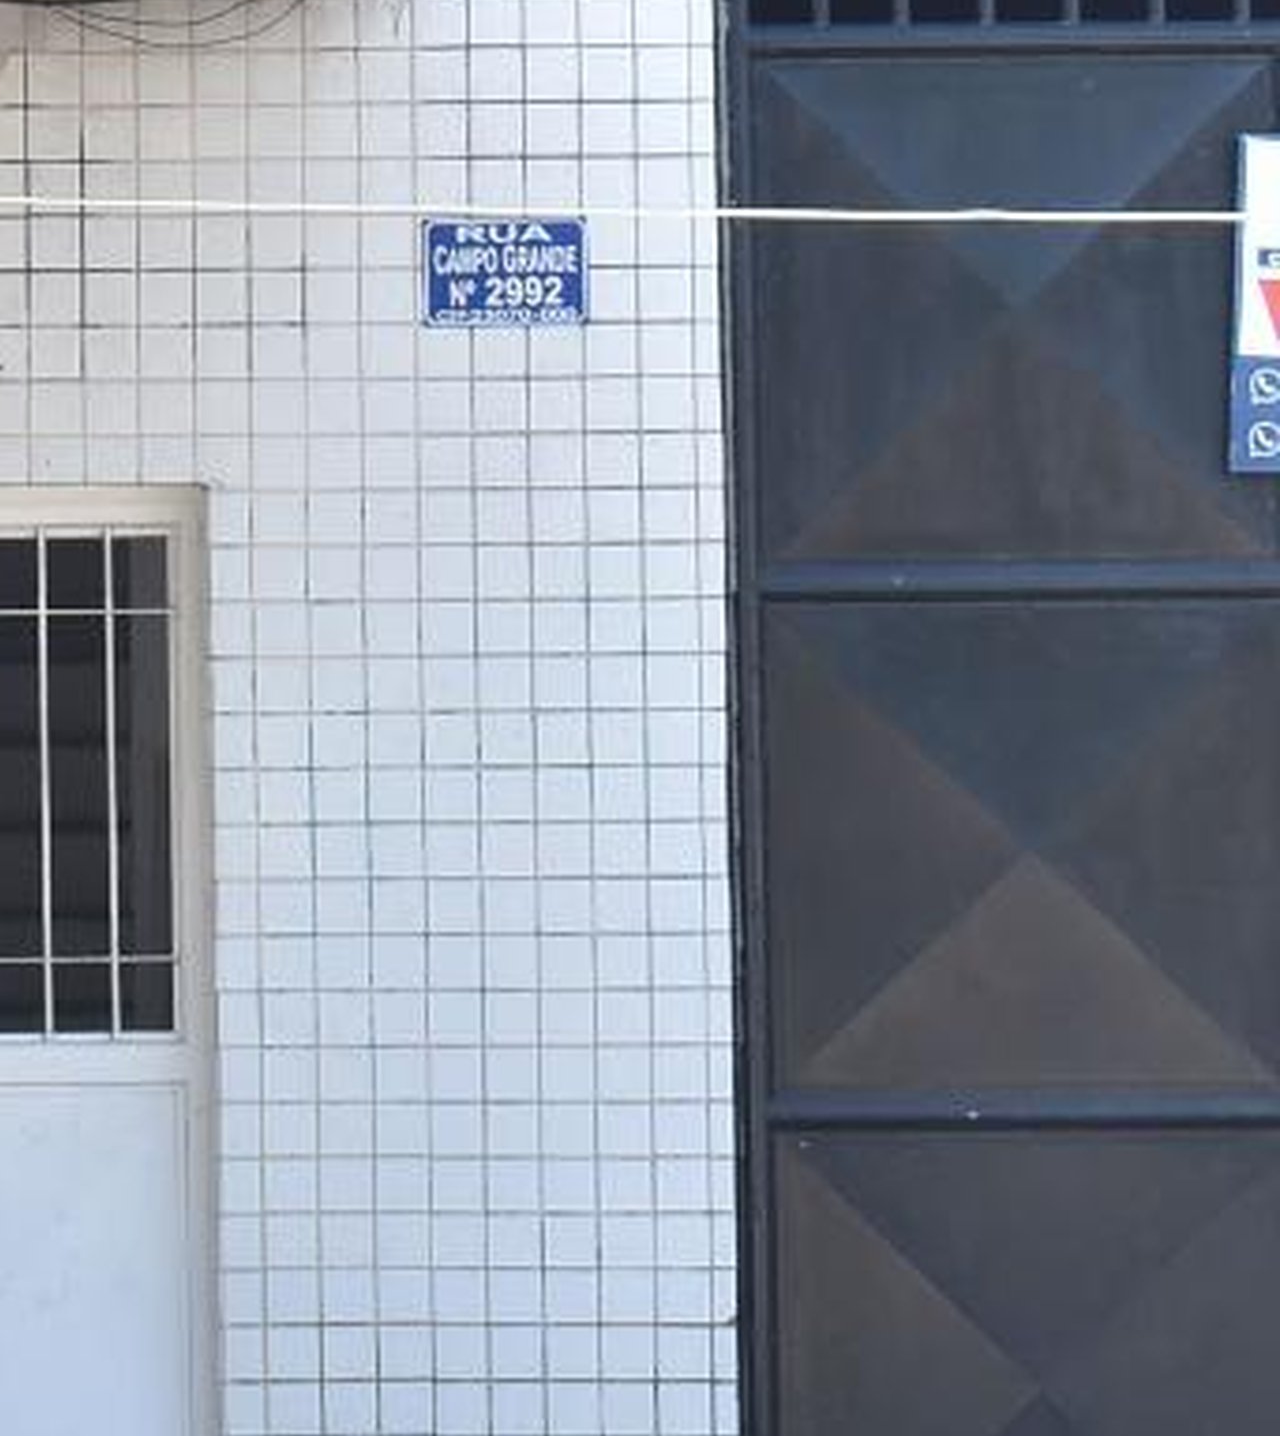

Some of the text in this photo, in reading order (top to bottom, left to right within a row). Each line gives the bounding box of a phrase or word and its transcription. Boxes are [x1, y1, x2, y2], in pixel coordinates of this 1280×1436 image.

[455, 224, 552, 243] RUA
[433, 245, 579, 274] CAMPO GRANDE
[484, 276, 565, 306] 2992
